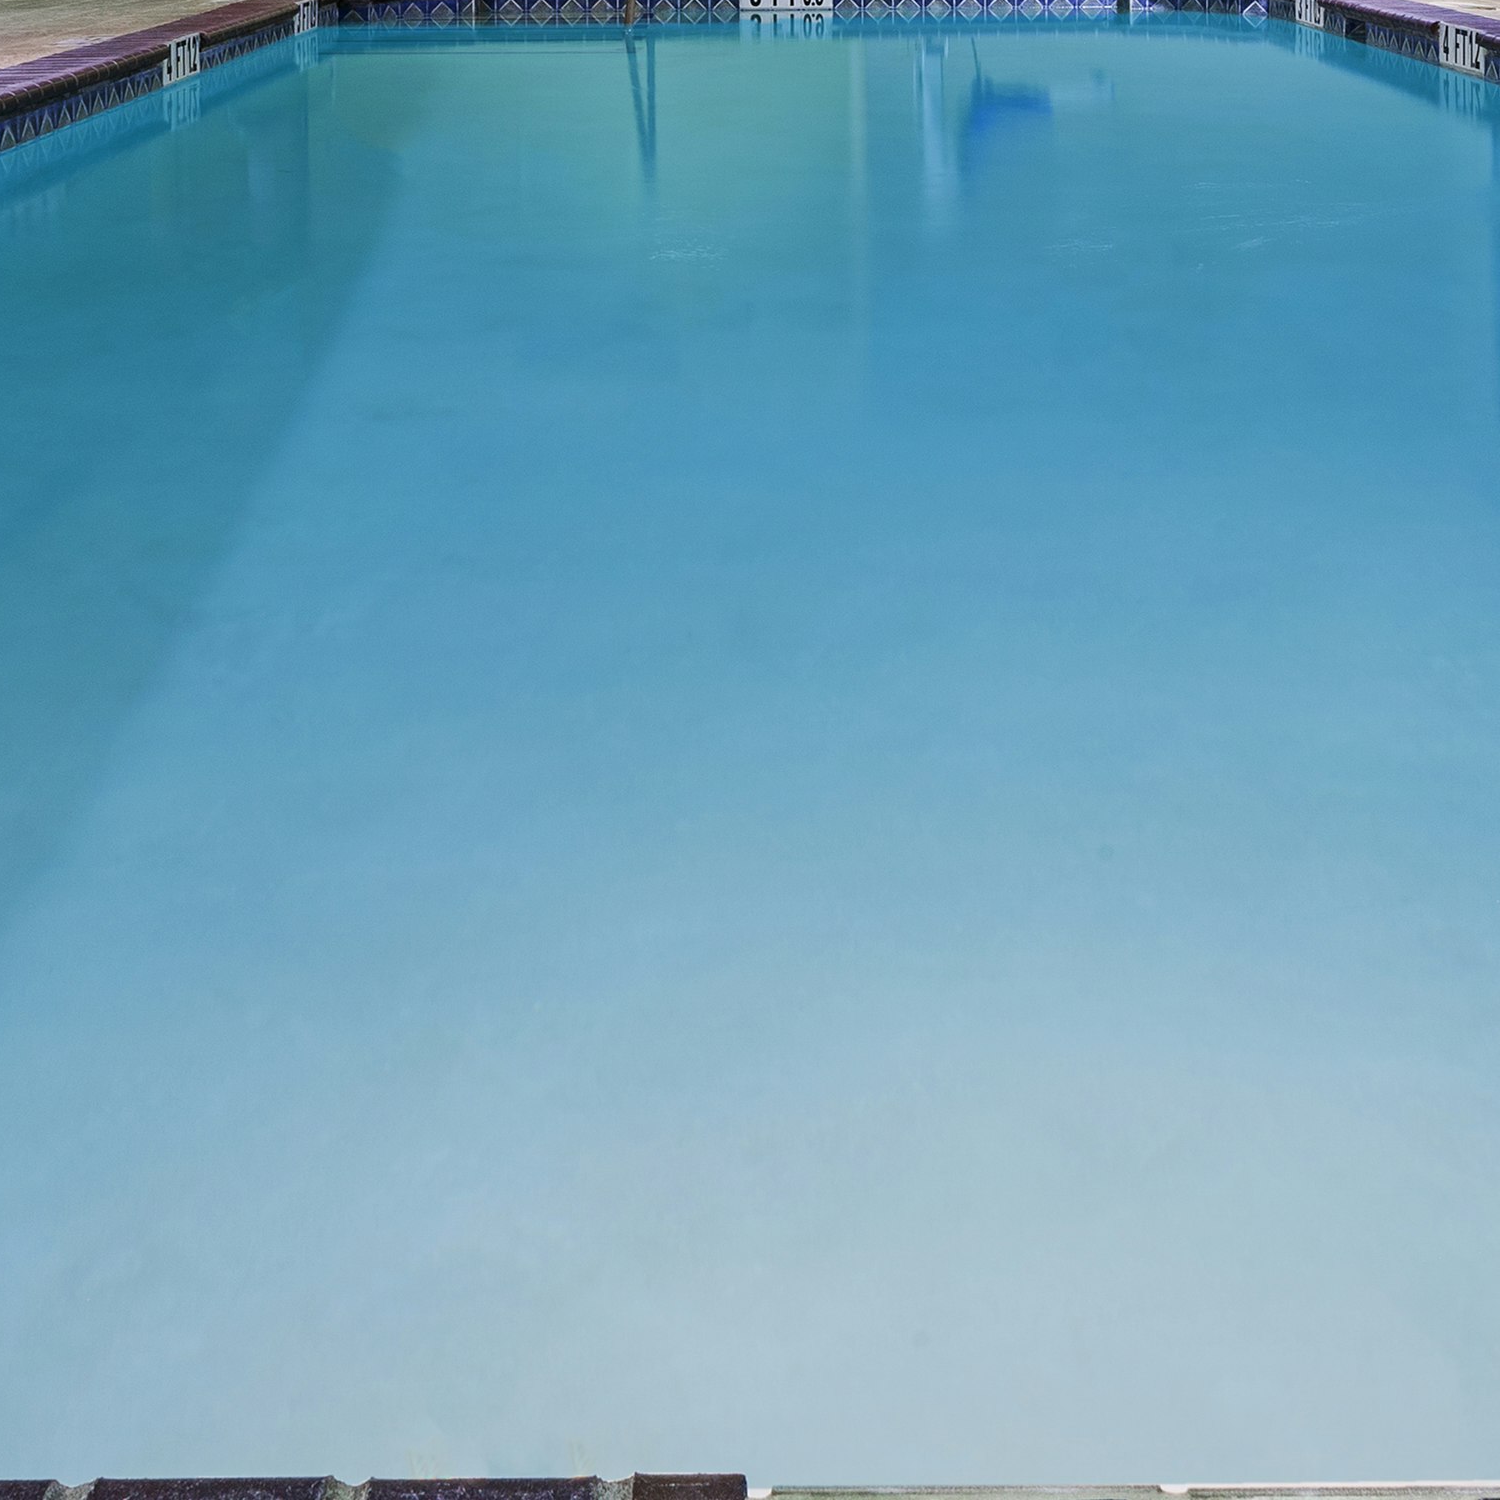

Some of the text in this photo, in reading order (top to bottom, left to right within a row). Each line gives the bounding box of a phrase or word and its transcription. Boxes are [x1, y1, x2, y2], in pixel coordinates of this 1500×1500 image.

[167, 44, 172, 81] 4
[176, 40, 186, 78] FT
[1443, 26, 1449, 61] 4
[1455, 28, 1468, 66] FT
